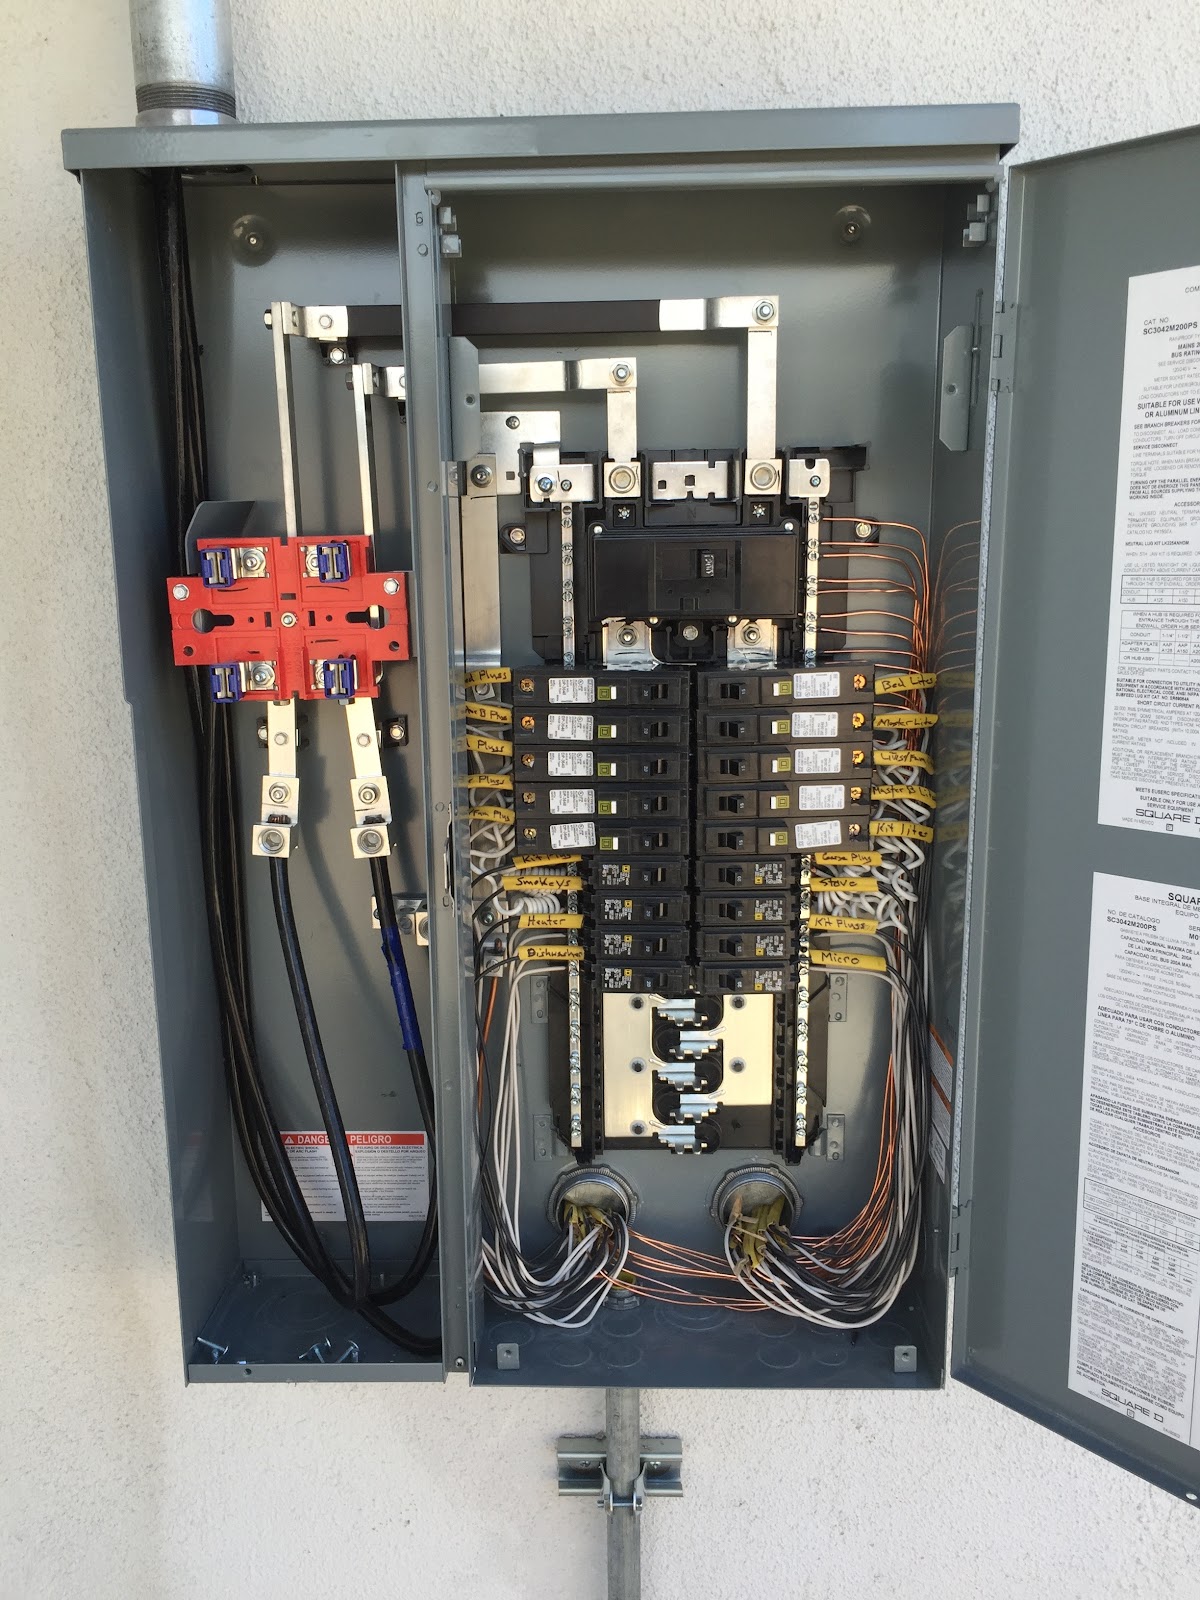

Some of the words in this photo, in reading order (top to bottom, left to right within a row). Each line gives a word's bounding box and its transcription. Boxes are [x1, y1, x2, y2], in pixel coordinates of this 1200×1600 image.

[1142, 322, 1198, 336] SC3042M200PS
[1137, 401, 1167, 410] SUITABLE
[1168, 399, 1181, 407] FOR
[1156, 408, 1188, 417] ALUMINUM
[881, 678, 906, 691] Bed
[872, 786, 904, 798] Master
[907, 785, 916, 794] B
[1167, 805, 1194, 813] EQUIPMENT
[1136, 808, 1190, 823] SQUARE
[876, 823, 894, 834] Kit
[819, 878, 857, 887] Stove
[1152, 899, 1181, 908] INTEGRAL
[1128, 913, 1161, 924] CATALOGO
[1175, 909, 1199, 918] EQUIPO
[527, 915, 566, 926] Heater
[815, 918, 832, 927] Kit
[1106, 916, 1157, 932] SC3042M200PS
[1121, 935, 1146, 945] CAPACIDAD
[1146, 940, 1166, 948] NOMINAL
[822, 953, 860, 965] Micro
[1098, 1005, 1124, 1016] ADECUADO
[1147, 1024, 1164, 1033] COBRE
[1170, 1031, 1195, 1041] ALUMINIO
[1133, 1126, 1161, 1138] ACCESORIOS
[297, 1135, 330, 1144] DANGE
[350, 1135, 392, 1144] PELIGRO
[1101, 1388, 1150, 1417] SQUARE
[1153, 1412, 1164, 1423] D
